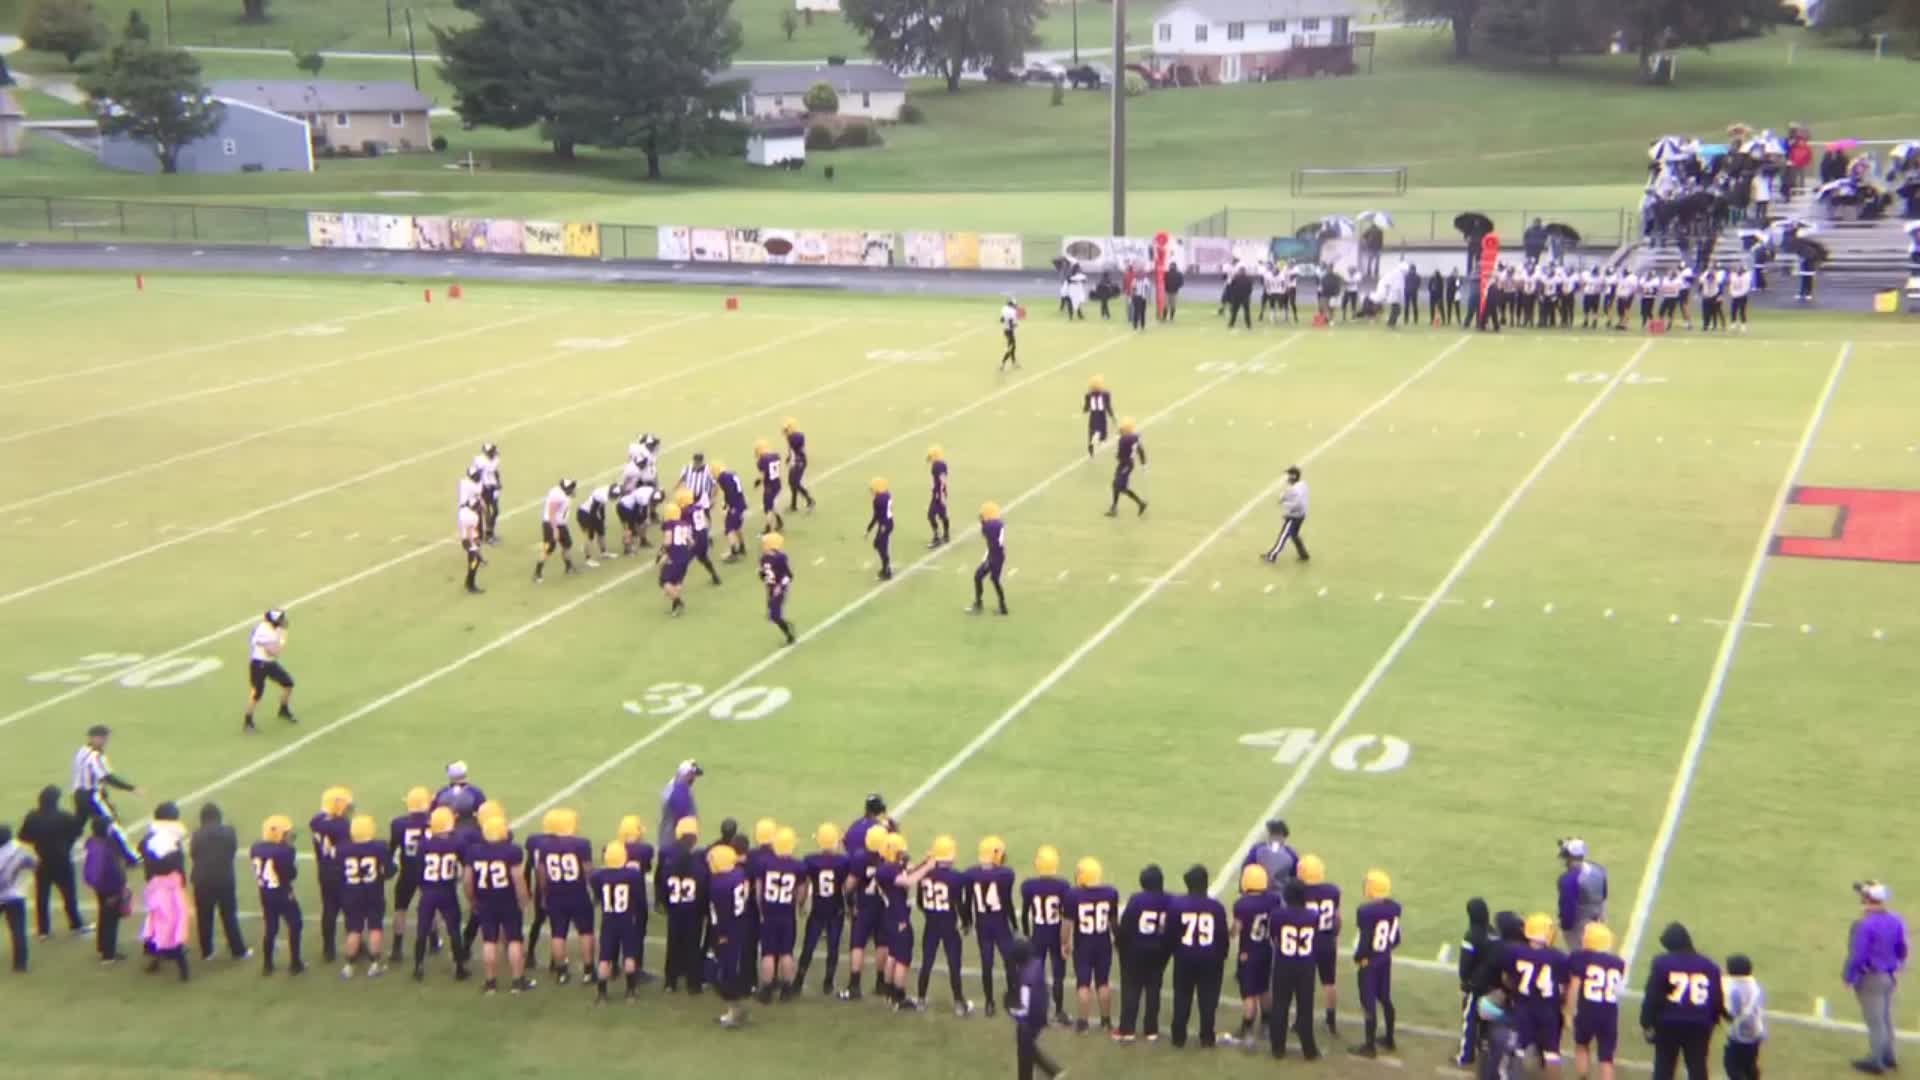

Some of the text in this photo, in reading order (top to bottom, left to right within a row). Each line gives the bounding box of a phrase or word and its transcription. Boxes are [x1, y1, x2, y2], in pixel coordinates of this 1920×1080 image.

[27, 652, 222, 688] 20
[623, 682, 791, 720] 30
[1238, 727, 1410, 771] 40
[344, 856, 377, 884] 23
[424, 853, 457, 881] 20
[474, 860, 508, 888] 72
[546, 853, 579, 881] 69
[602, 883, 630, 912] 18
[668, 876, 696, 903] 33
[764, 872, 796, 904] 52
[818, 870, 835, 897] 6
[922, 880, 950, 911] 22
[974, 882, 1002, 912] 14
[1078, 901, 1110, 935] 56
[1181, 912, 1215, 946] 79
[1280, 924, 1314, 956] 63
[1516, 960, 1553, 997] 74
[1668, 971, 1709, 1004] 76
